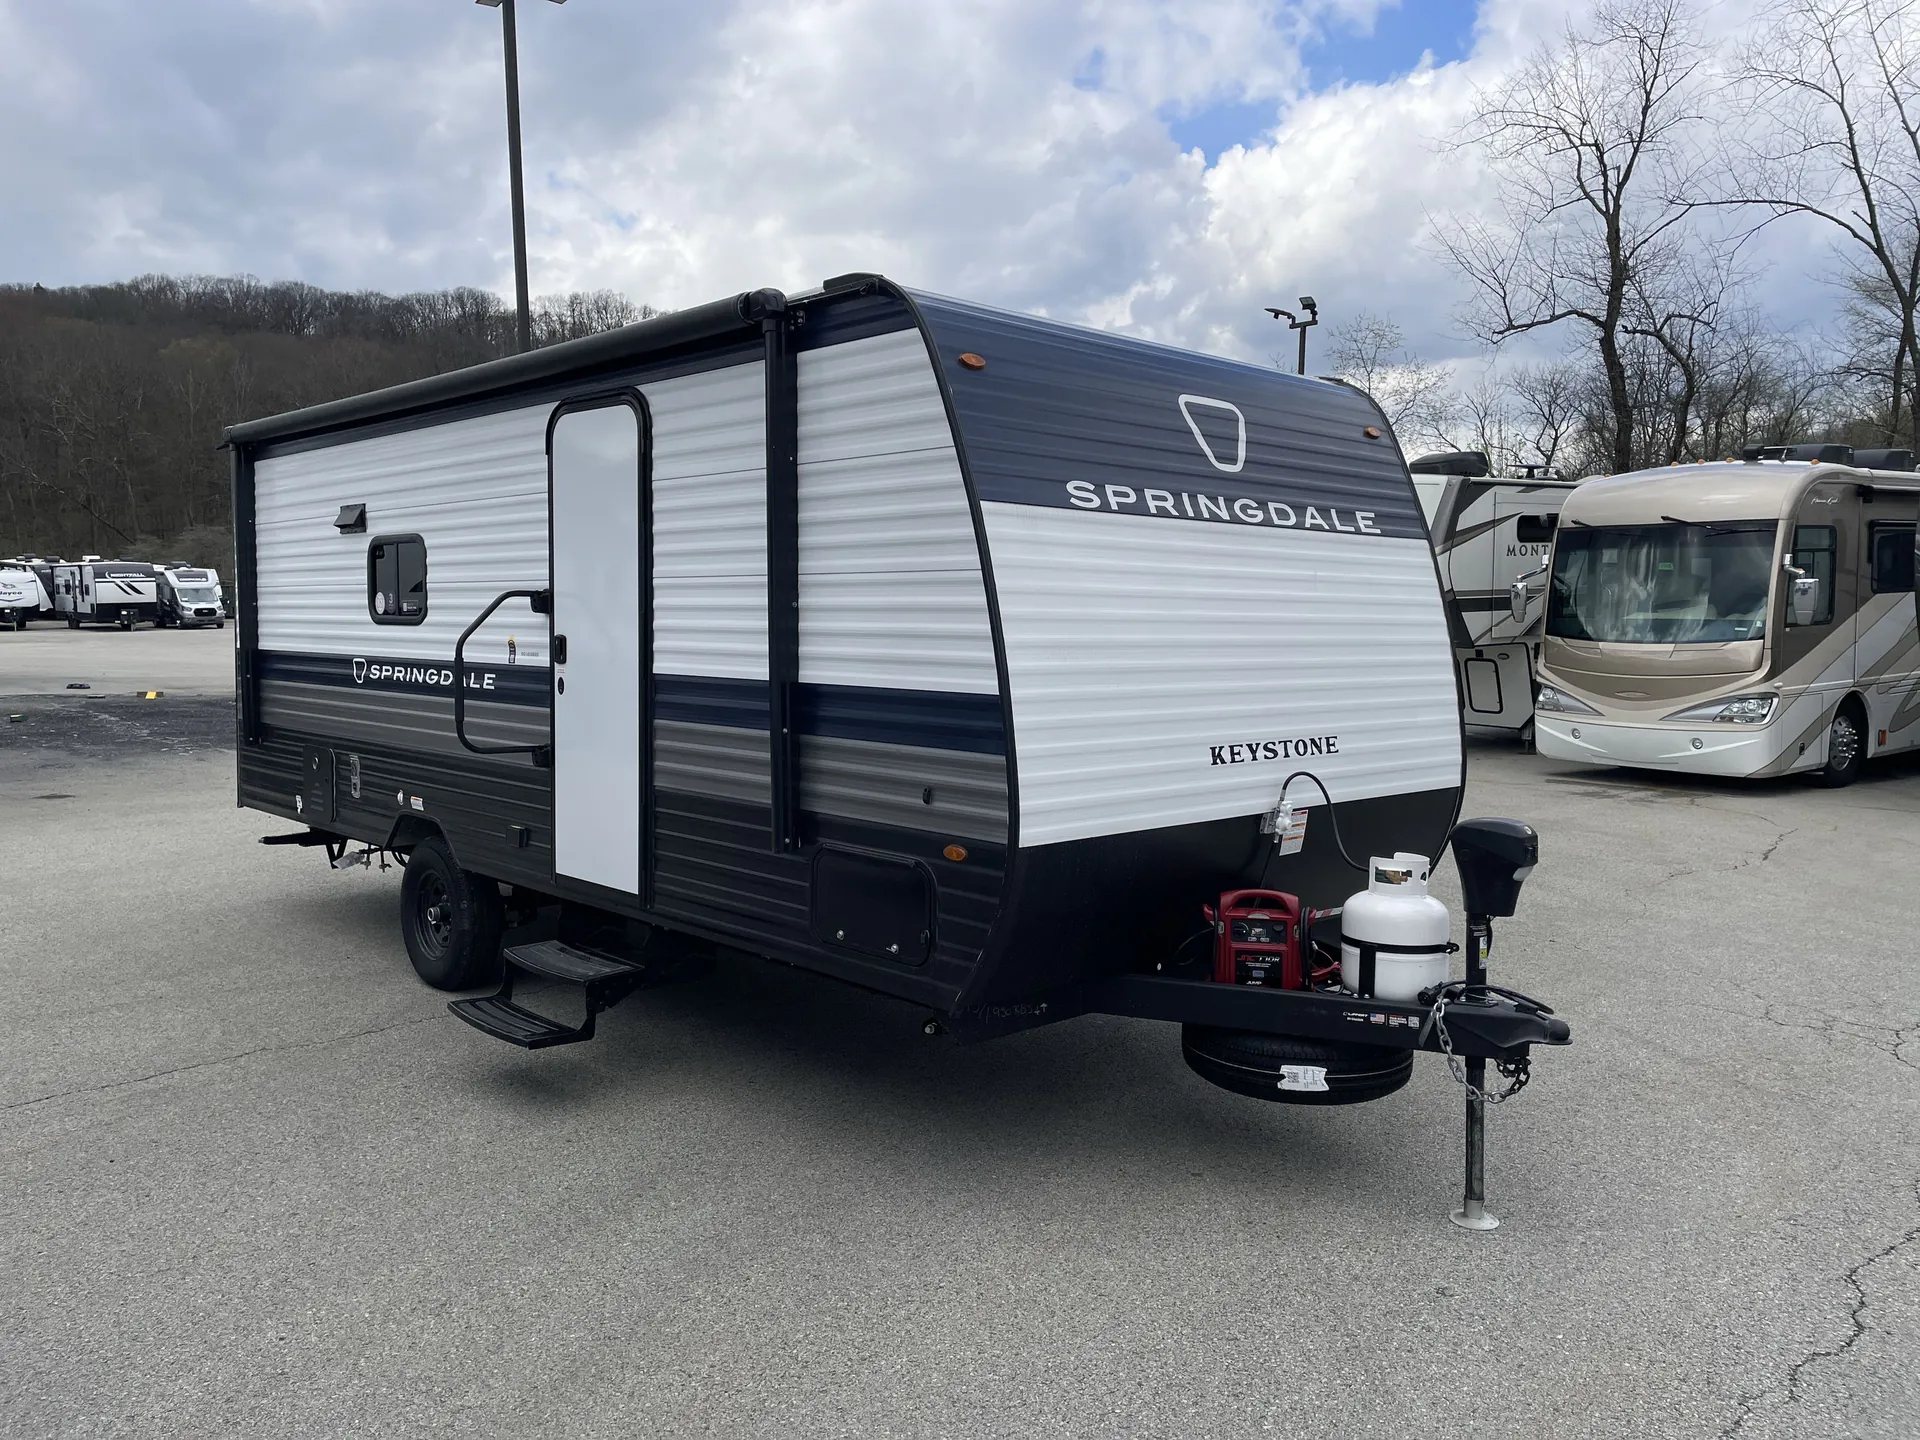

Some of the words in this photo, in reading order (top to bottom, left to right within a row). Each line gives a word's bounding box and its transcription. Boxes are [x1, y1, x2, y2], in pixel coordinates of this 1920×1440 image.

[1066, 480, 1381, 534] SPRINGDALE
[1506, 544, 1549, 556] MONT
[369, 664, 496, 690] SPRINGDLE
[1209, 736, 1339, 766] KEYSTONE
